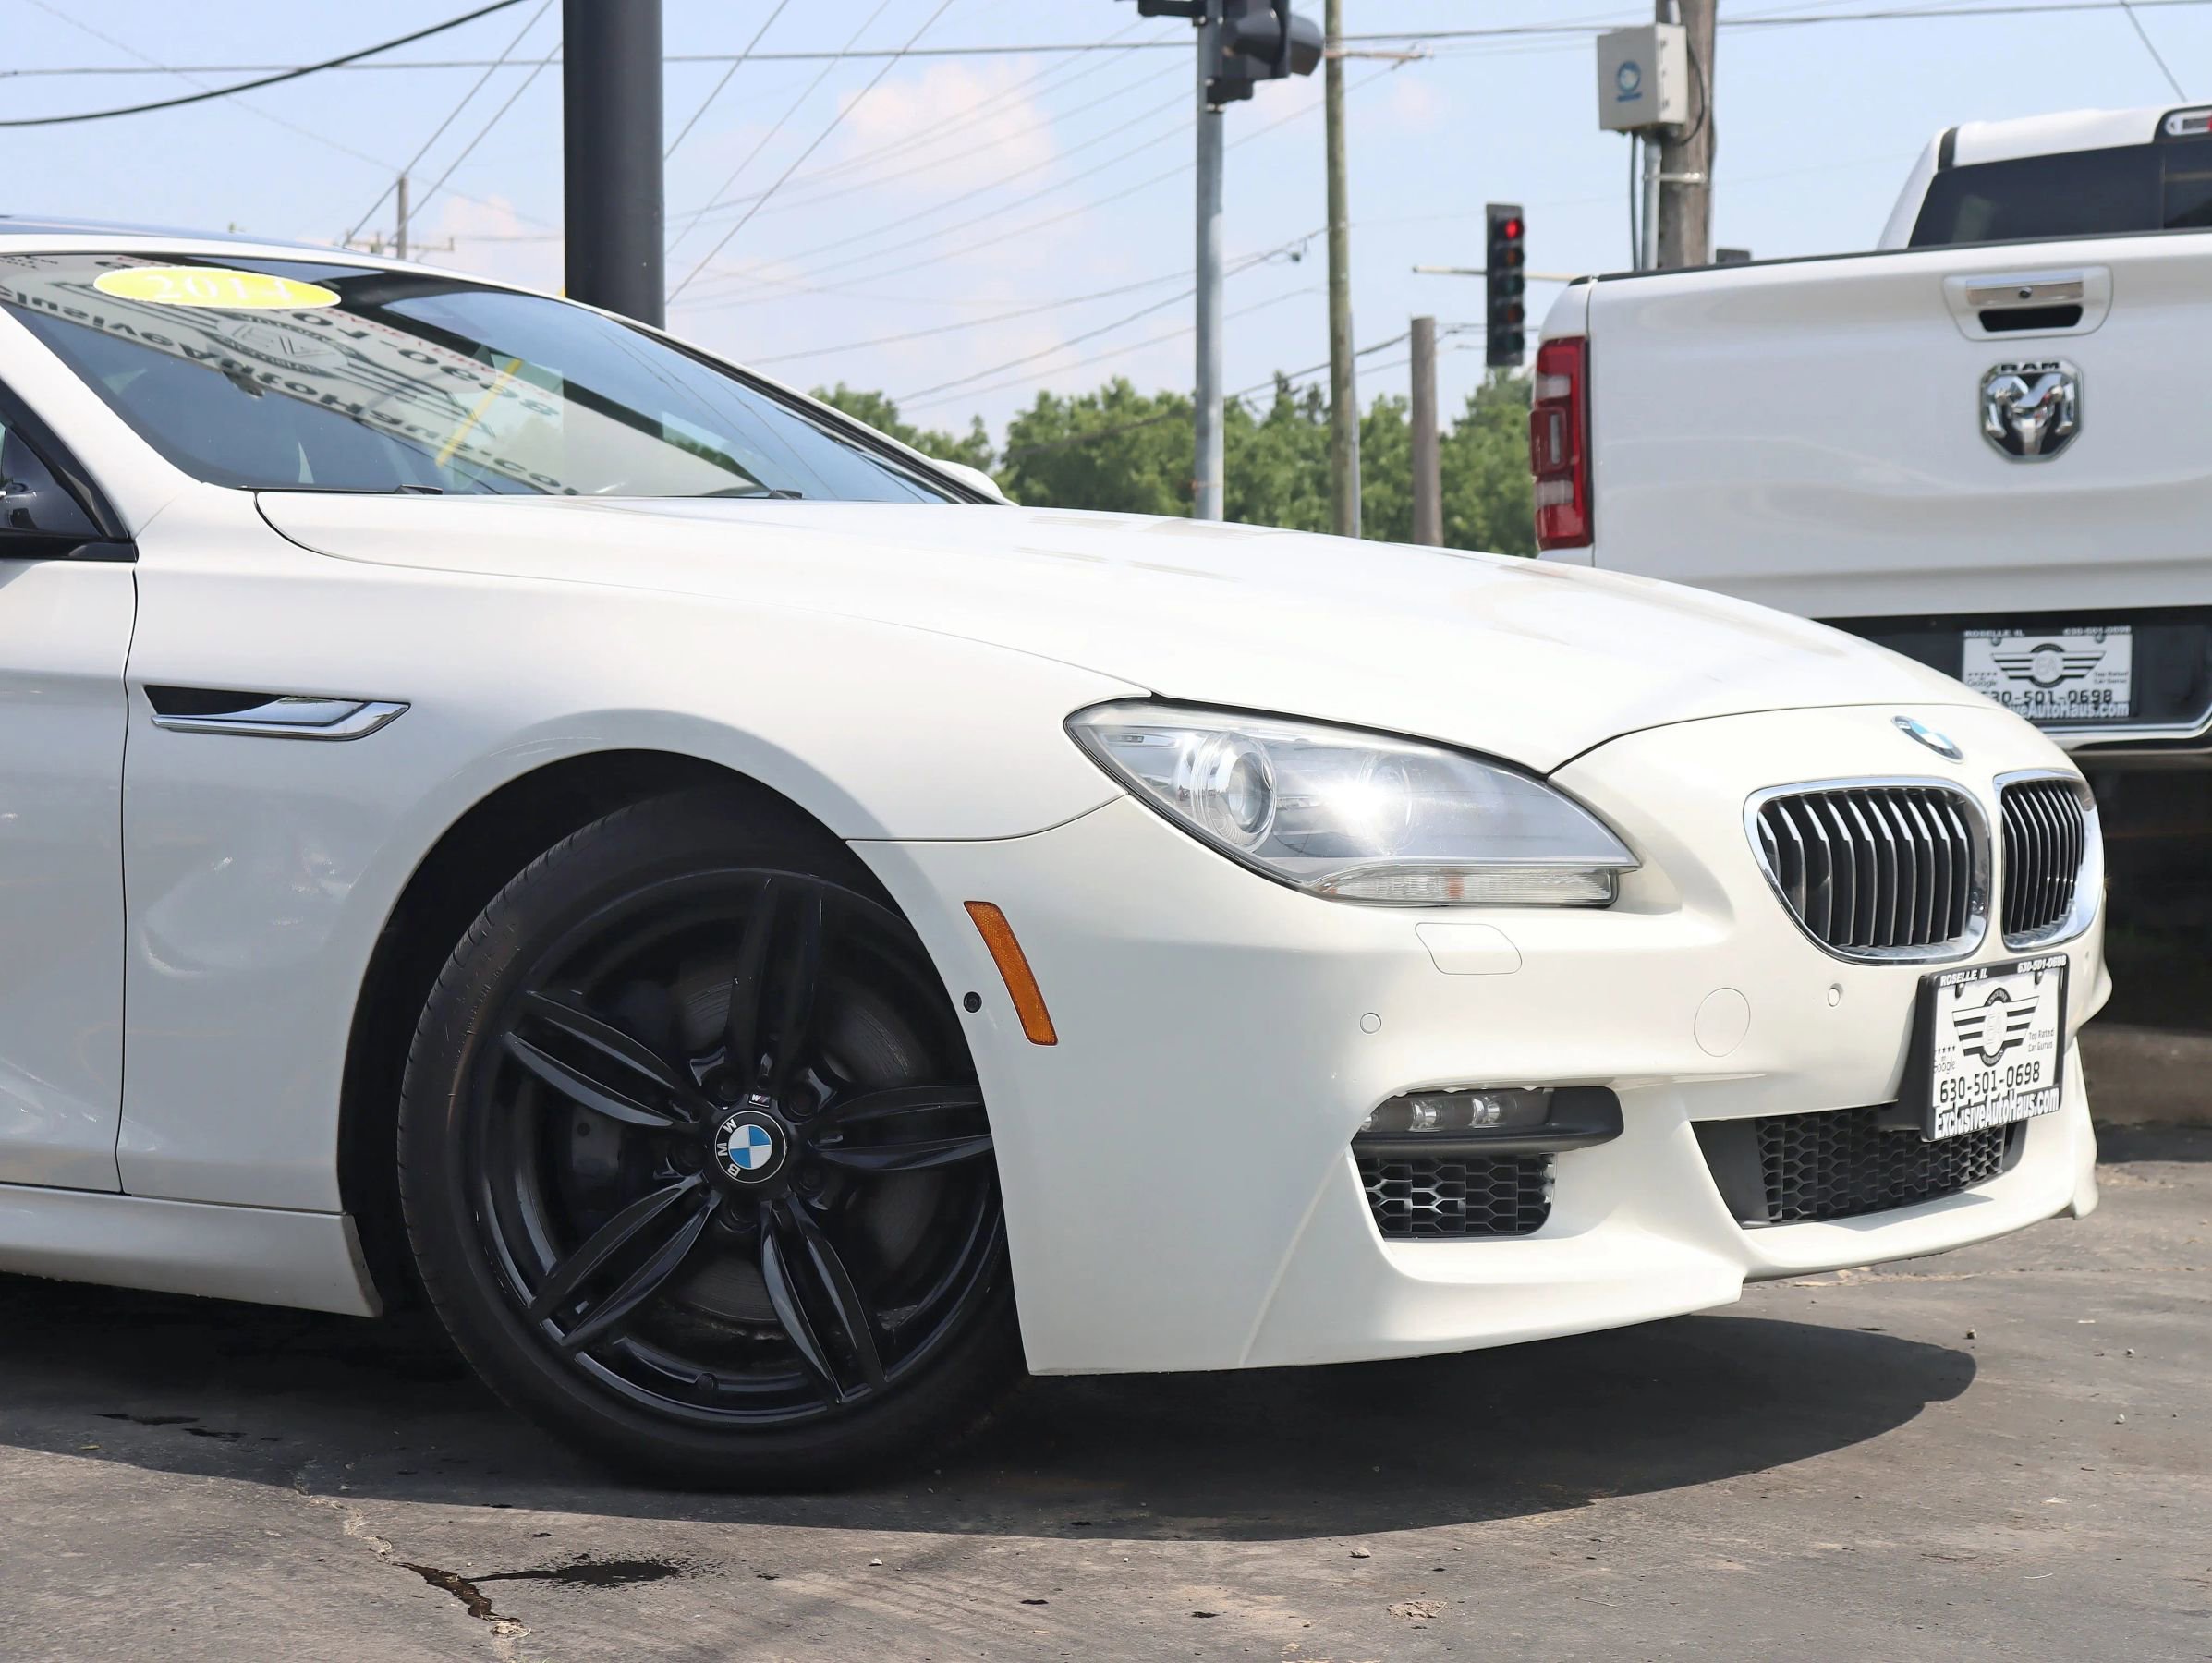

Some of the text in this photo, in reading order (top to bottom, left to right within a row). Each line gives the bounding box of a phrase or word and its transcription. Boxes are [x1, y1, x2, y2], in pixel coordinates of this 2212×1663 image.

[2000, 362, 2060, 371] RAM
[1980, 689, 2112, 704] 30-501-0698
[1979, 967, 1988, 980] IL
[2017, 955, 2067, 974] 630-501-0698
[1940, 1061, 2040, 1103] 630-501-0698
[1935, 1087, 2060, 1139] ExclusiveAutoHaus.com
[716, 1119, 741, 1177] BMW
